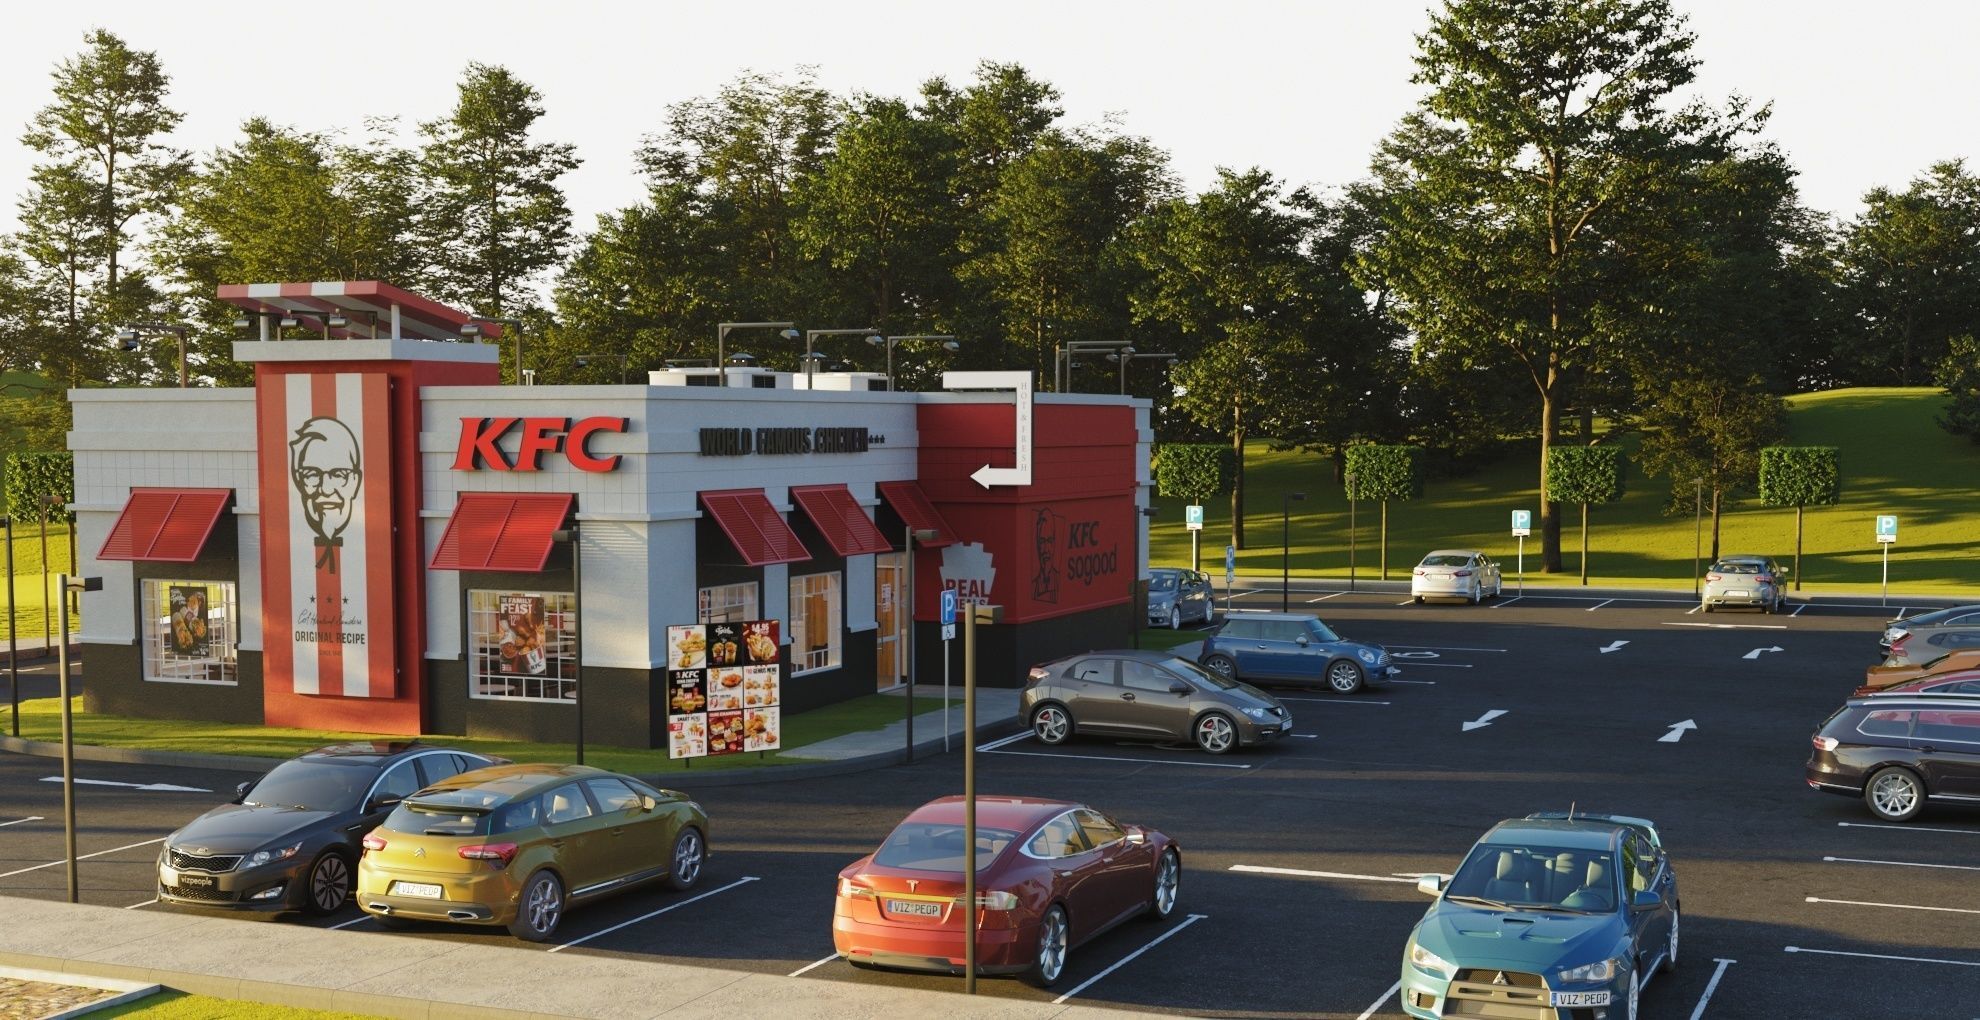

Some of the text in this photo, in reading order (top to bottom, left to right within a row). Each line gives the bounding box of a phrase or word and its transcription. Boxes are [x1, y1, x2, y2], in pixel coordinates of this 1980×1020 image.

[450, 416, 630, 473] KFC
[699, 427, 869, 456] WORLD FAMOUS CHICKEN
[1068, 520, 1099, 549] KFC
[1068, 542, 1117, 586] sogood
[945, 578, 993, 598] REAL
[500, 603, 533, 615] FEAST
[945, 594, 955, 621] P
[295, 630, 366, 645] ORIGINAL RECIPE
[681, 670, 700, 678] KFC
[180, 876, 213, 887] vizpeople
[894, 901, 910, 913] VIZ
[1560, 994, 1579, 1005] VIZ
